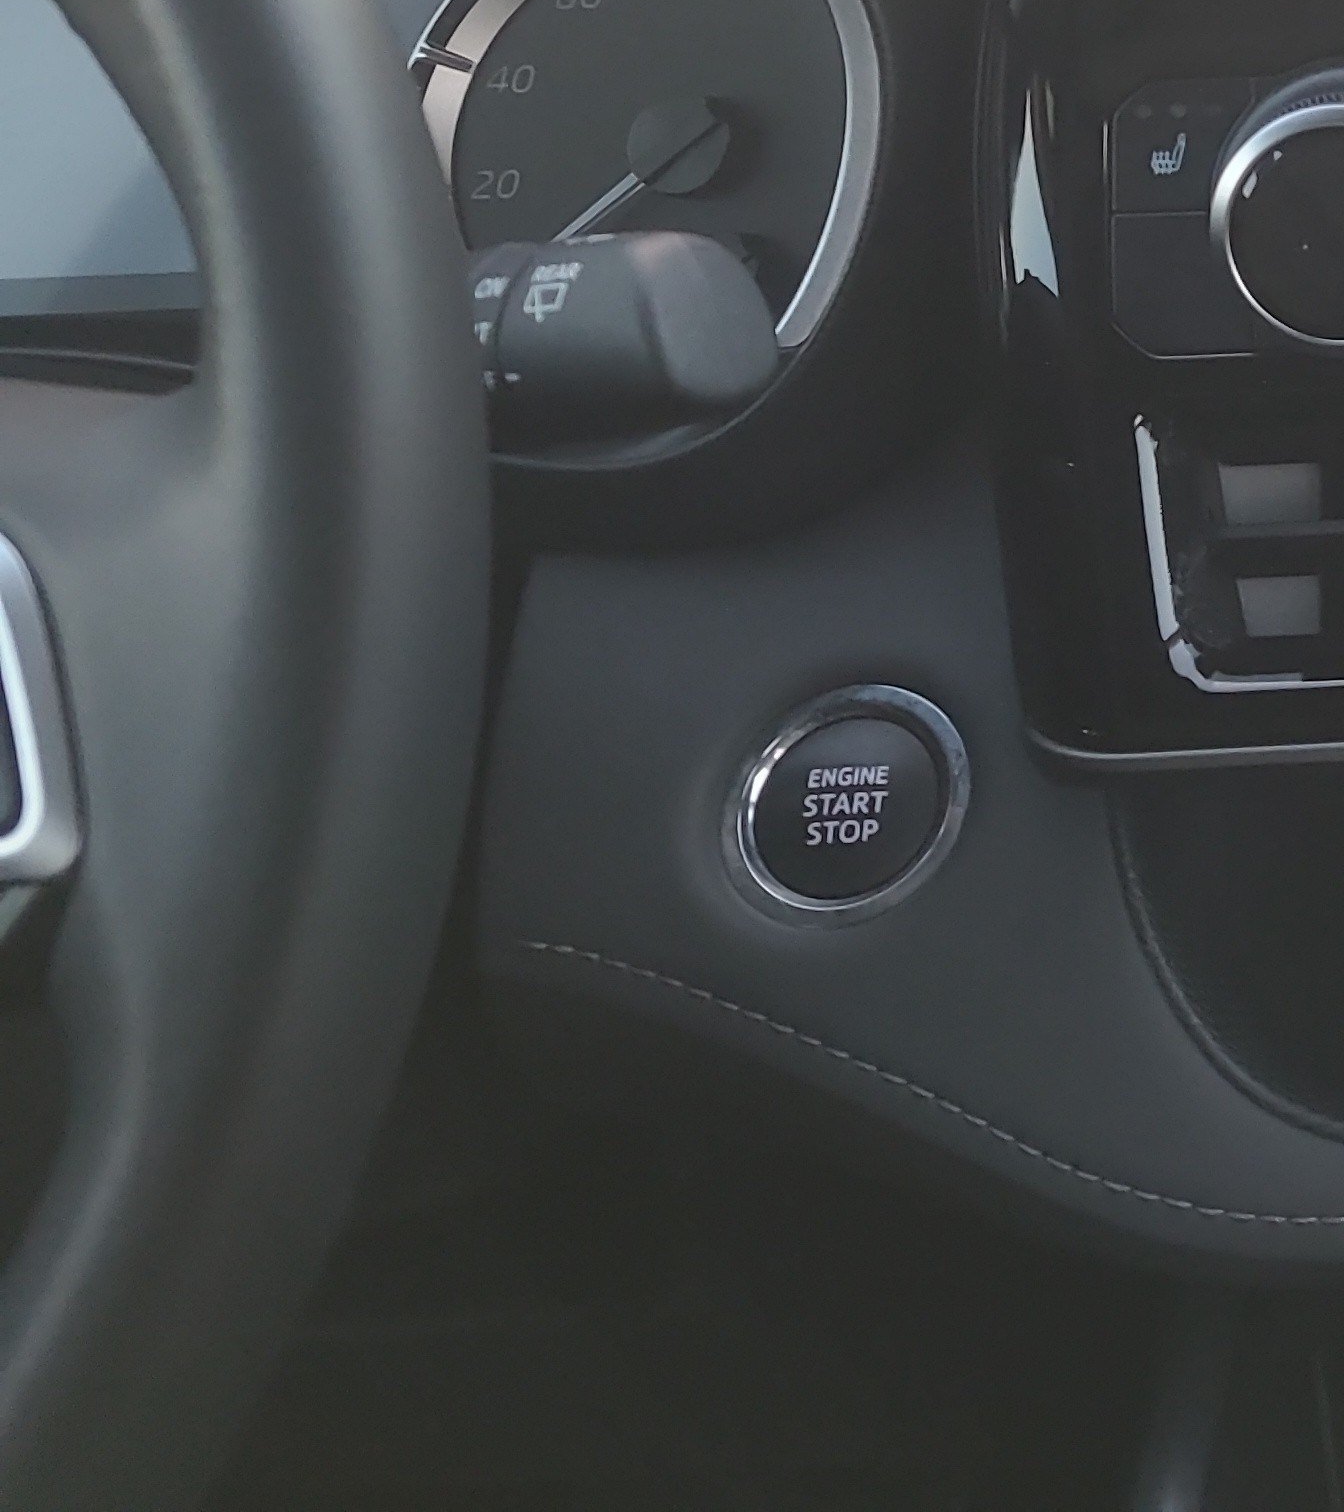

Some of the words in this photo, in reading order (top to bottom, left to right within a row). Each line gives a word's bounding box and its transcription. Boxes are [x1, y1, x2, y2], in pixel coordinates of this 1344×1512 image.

[486, 64, 536, 94] 40
[470, 169, 521, 200] 20
[531, 262, 583, 283] REAR
[807, 765, 890, 789] ENGINE
[802, 790, 889, 818] START
[806, 818, 880, 846] STOP
